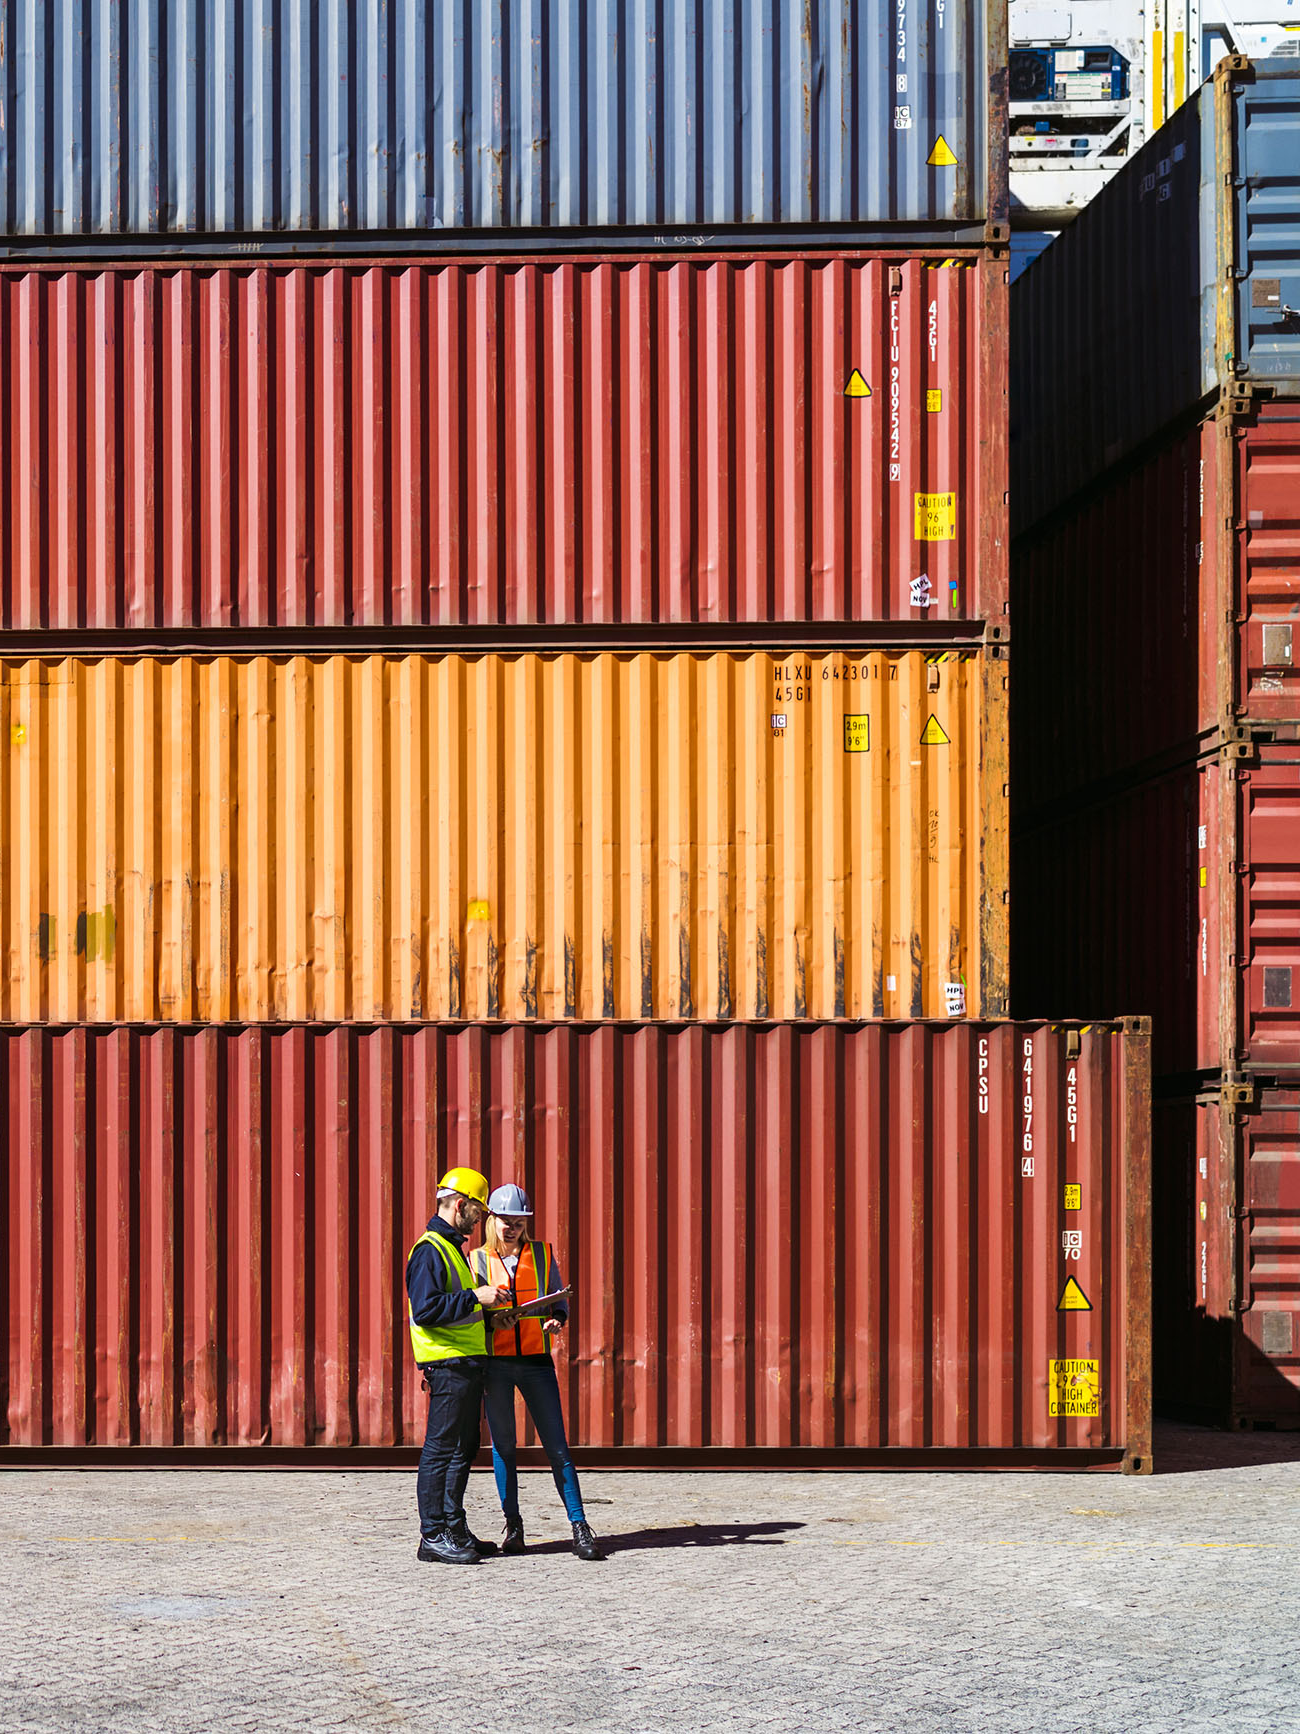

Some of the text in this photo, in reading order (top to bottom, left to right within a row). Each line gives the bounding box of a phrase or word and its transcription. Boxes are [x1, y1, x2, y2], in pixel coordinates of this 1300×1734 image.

[897, 0, 906, 62] 9734
[891, 301, 899, 362] FCIU
[928, 300, 937, 362] 45G1
[891, 367, 899, 458] 909542
[924, 525, 944, 537] HIGH
[913, 579, 929, 590] HPL
[913, 595, 928, 604] NOV
[774, 666, 812, 681] HLXU
[822, 665, 878, 680] 642301
[775, 686, 811, 702] 45G1
[773, 729, 784, 737] 81
[947, 987, 964, 995] HPL
[949, 1002, 964, 1011] NOV
[979, 1039, 988, 1113] CPSU
[1022, 1038, 1034, 1177] 641976 4
[1067, 1067, 1077, 1142] 45G1
[1064, 1248, 1081, 1260] 70
[1053, 1361, 1094, 1373] CAUTION
[1062, 1388, 1082, 1400] HIGH
[1050, 1401, 1097, 1414] CONTAINER
